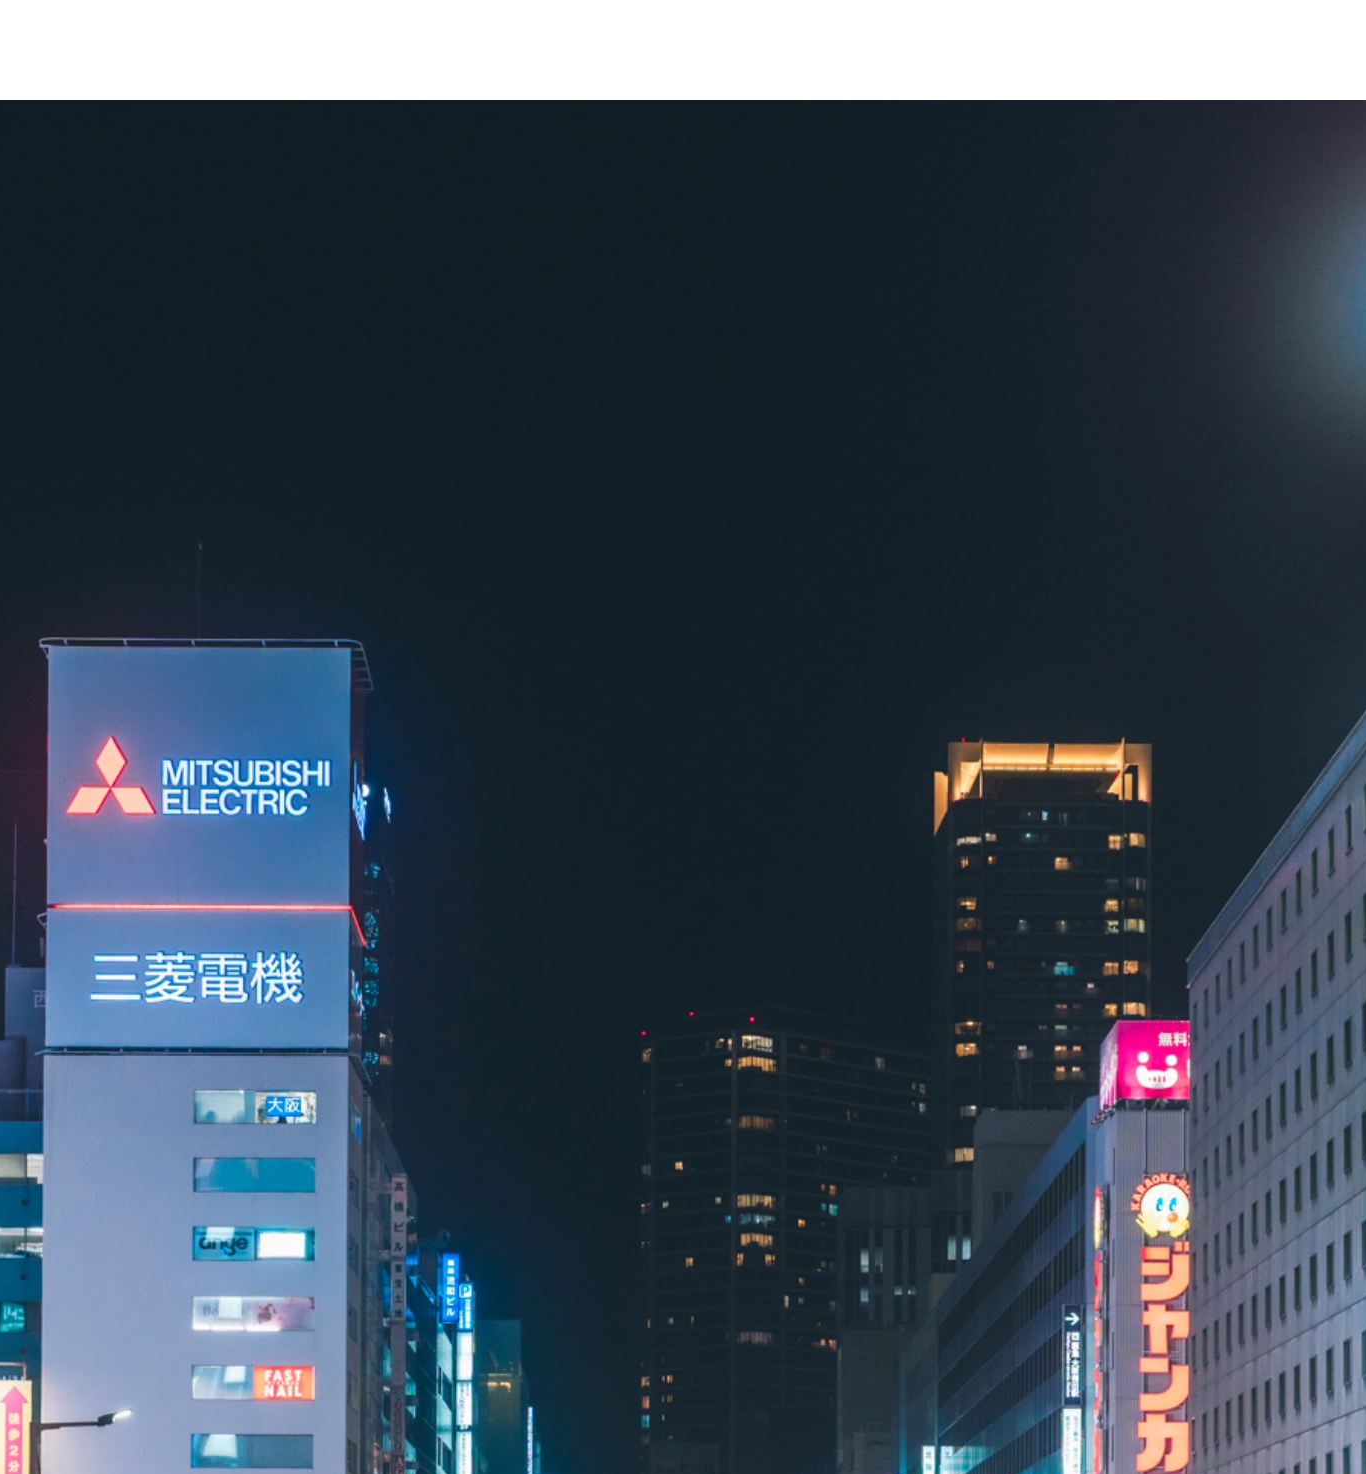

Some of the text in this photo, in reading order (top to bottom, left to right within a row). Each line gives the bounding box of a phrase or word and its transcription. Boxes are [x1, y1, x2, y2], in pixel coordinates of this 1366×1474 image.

[161, 759, 331, 787] MITSUBISHI
[161, 789, 309, 816] ELECTRIC
[90, 951, 304, 1004] 三菱電機
[1158, 1031, 1190, 1047] 無料
[267, 1097, 302, 1114] 大阪
[264, 1369, 302, 1382] FAST
[264, 1385, 302, 1398] NAIL
